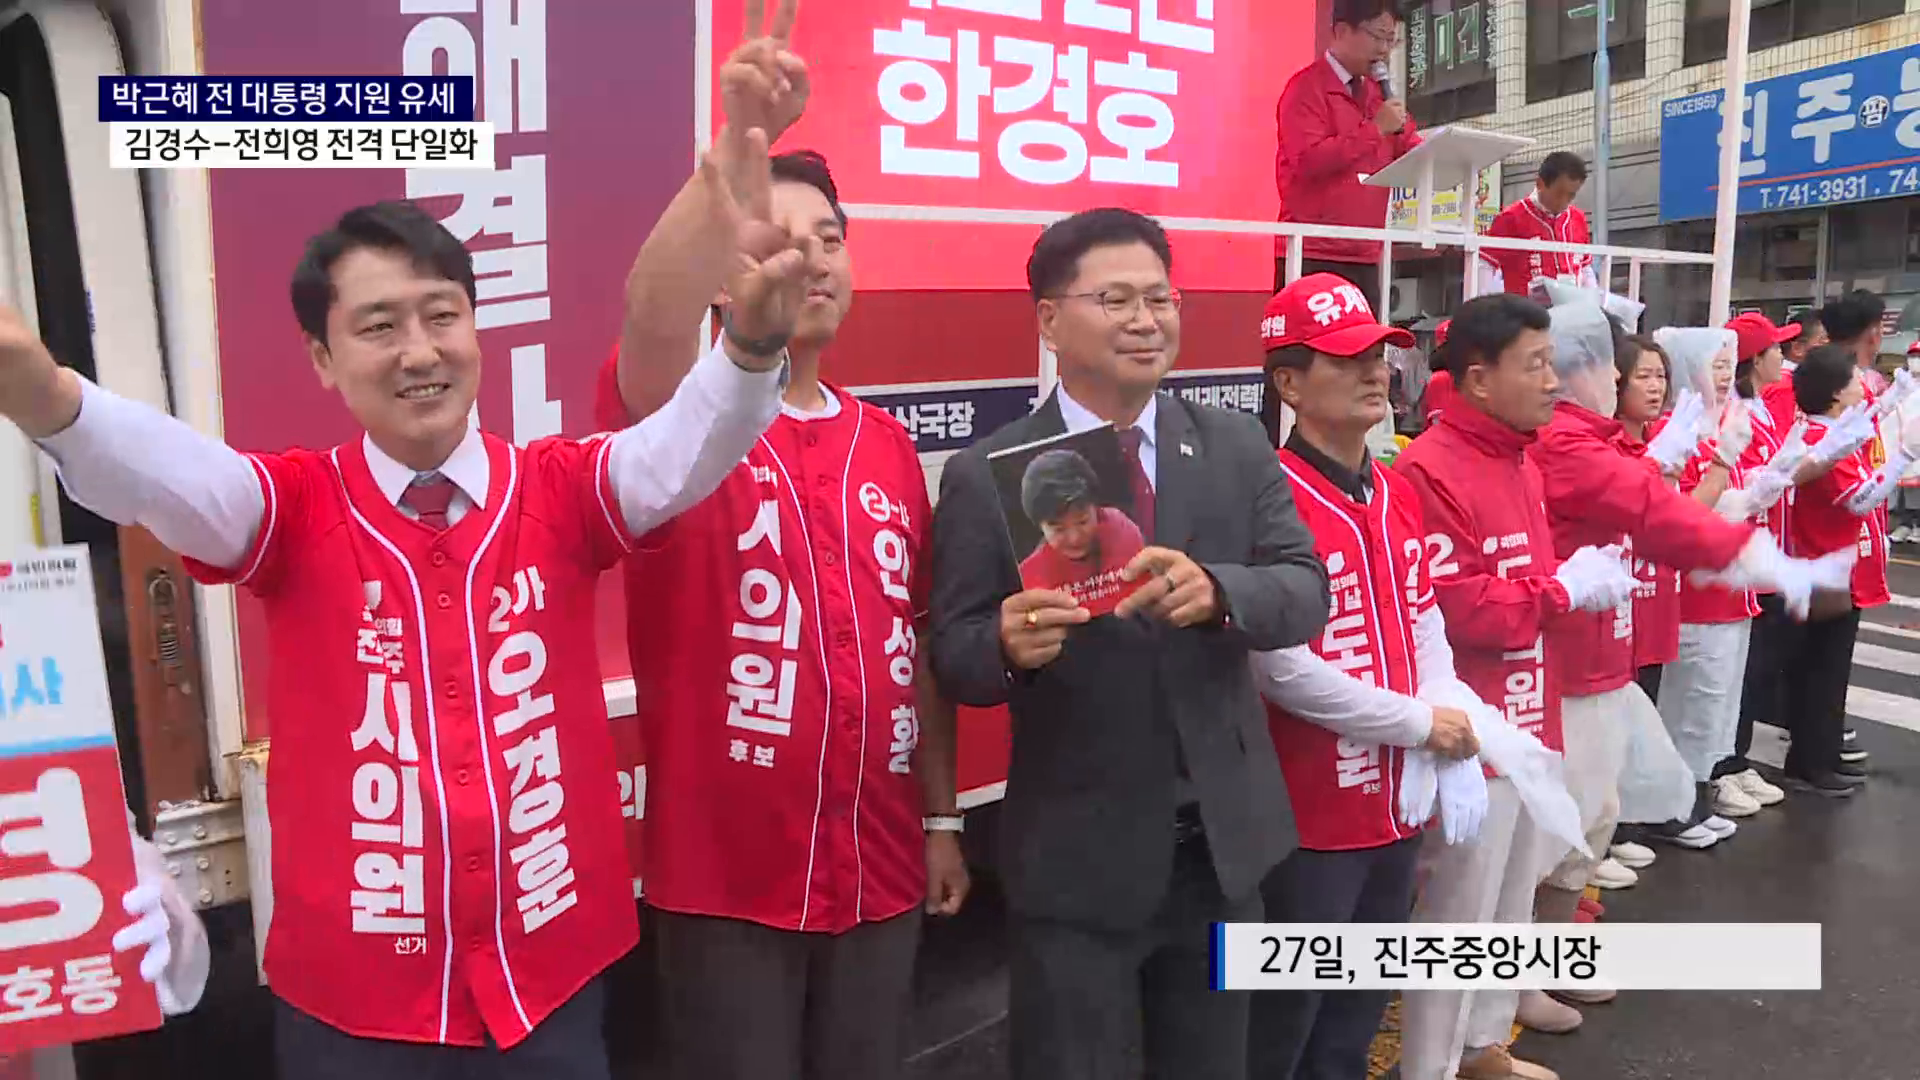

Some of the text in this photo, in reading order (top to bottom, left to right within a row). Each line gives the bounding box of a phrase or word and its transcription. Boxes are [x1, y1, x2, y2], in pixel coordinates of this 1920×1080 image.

[873, 18, 1179, 188] 한경호
[1664, 94, 1718, 118] SINCE1959
[884, 400, 976, 443] 산국장
[1425, 533, 1459, 579] 2
[725, 500, 803, 738] 시의원
[356, 628, 406, 675] 진주
[1322, 613, 1382, 790] 도원
[728, 738, 776, 769] 후보
[350, 672, 427, 935] 시의원
[487, 630, 578, 935] 오경훈
[394, 936, 428, 955] 선거
